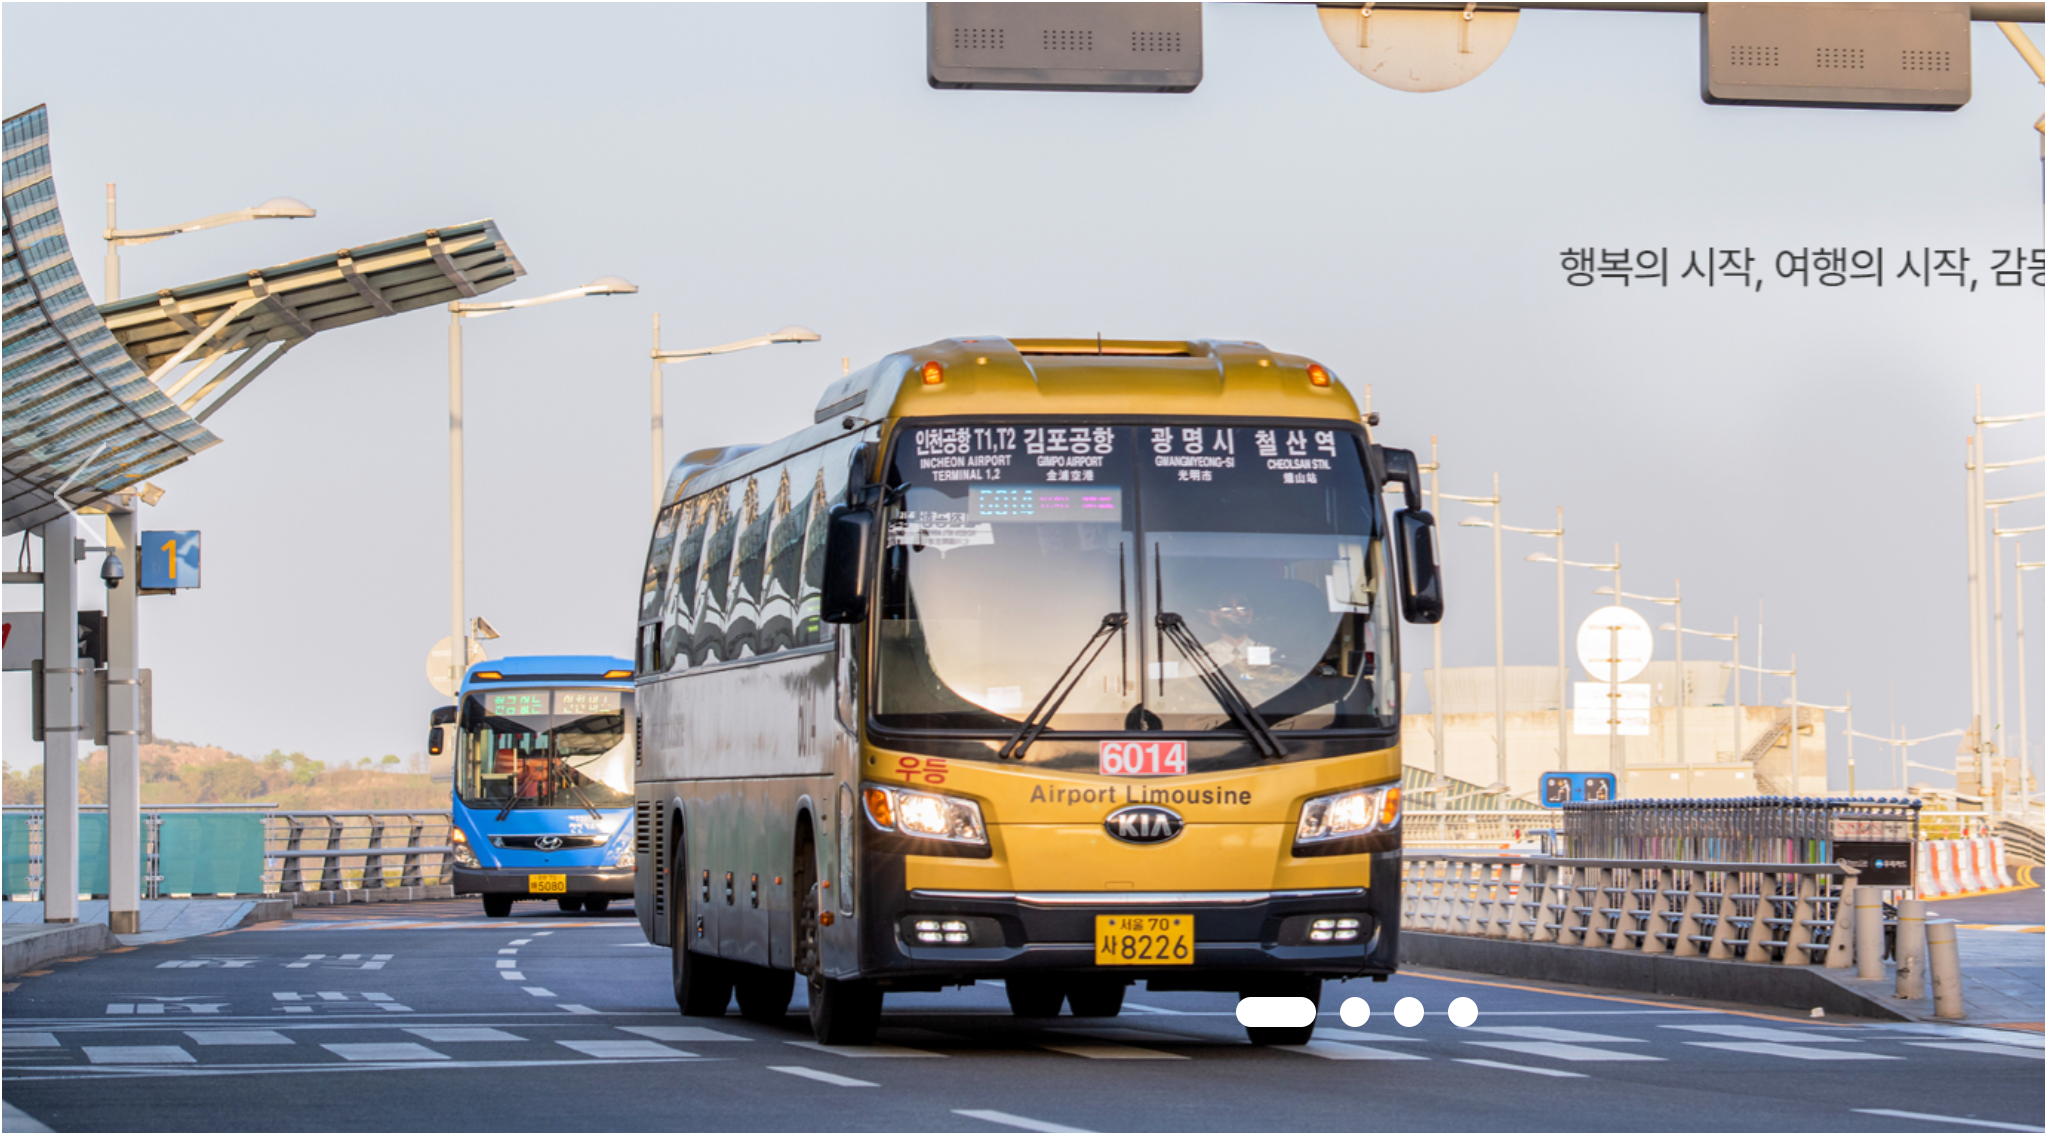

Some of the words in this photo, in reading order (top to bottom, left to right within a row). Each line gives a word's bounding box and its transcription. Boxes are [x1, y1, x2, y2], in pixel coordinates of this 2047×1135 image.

[915, 427, 971, 456] 인천공항
[974, 427, 1016, 453] T1,T2
[1023, 426, 1115, 455] 김포공항
[919, 456, 965, 469] INCHEON
[967, 455, 1012, 467] AIRPORT
[1036, 455, 1065, 467] GIMPO
[1066, 455, 1104, 467] AIRPORT
[1154, 455, 1235, 468] GWANGMYEONG-SI
[1266, 458, 1311, 470] CHEOLSAN
[931, 469, 983, 482] TERMINAL
[985, 468, 1001, 481] 1,2
[1177, 469, 1213, 482] 光明市
[160, 538, 177, 579] 1
[1102, 742, 1185, 774] 6014
[895, 756, 949, 784] 우등
[1030, 784, 1116, 806] Airport
[1126, 784, 1252, 805] Limousine
[1118, 813, 1173, 837] KIA
[1120, 918, 1144, 931] 서울
[1148, 918, 1170, 931] 70
